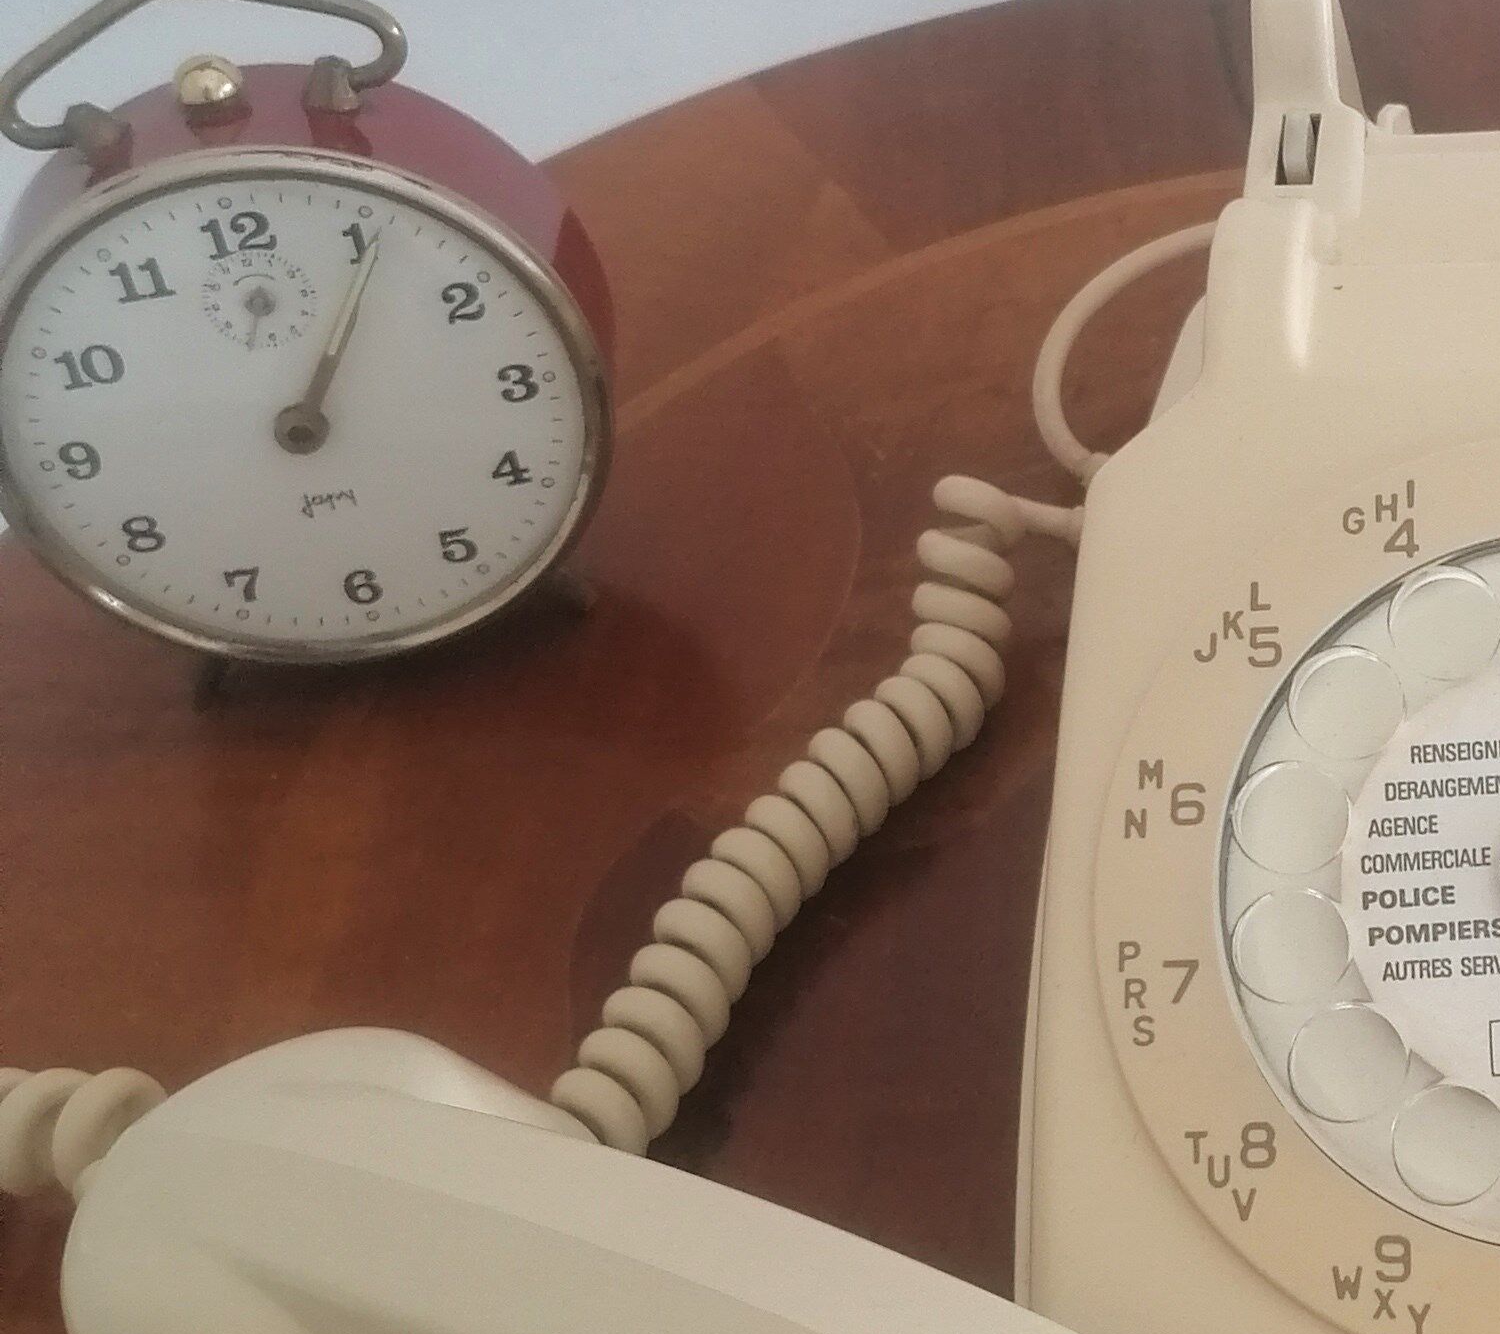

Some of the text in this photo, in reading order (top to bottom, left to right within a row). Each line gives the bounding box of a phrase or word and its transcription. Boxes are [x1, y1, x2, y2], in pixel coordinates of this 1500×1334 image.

[200, 210, 277, 261] 12
[341, 223, 379, 265] 1
[108, 258, 176, 304] 11
[441, 283, 485, 324] 2
[54, 345, 125, 390] 10
[497, 364, 539, 403] 3
[58, 441, 101, 480] 9
[492, 451, 532, 486] 4
[121, 516, 166, 553] 8
[438, 528, 477, 563] 5
[1383, 518, 1420, 558] 4
[223, 567, 259, 602] 7
[343, 570, 383, 605] 6
[1248, 626, 1282, 668] 5
[1170, 783, 1206, 826] 6
[1368, 815, 1438, 838] AGENCE
[1361, 847, 1491, 874] COMMERCIALE
[1362, 885, 1455, 910] POLICE
[1162, 959, 1199, 1004] 7
[1383, 958, 1452, 981] AUTRES
[1240, 1122, 1276, 1169] 8
[1375, 1235, 1411, 1283] 9
